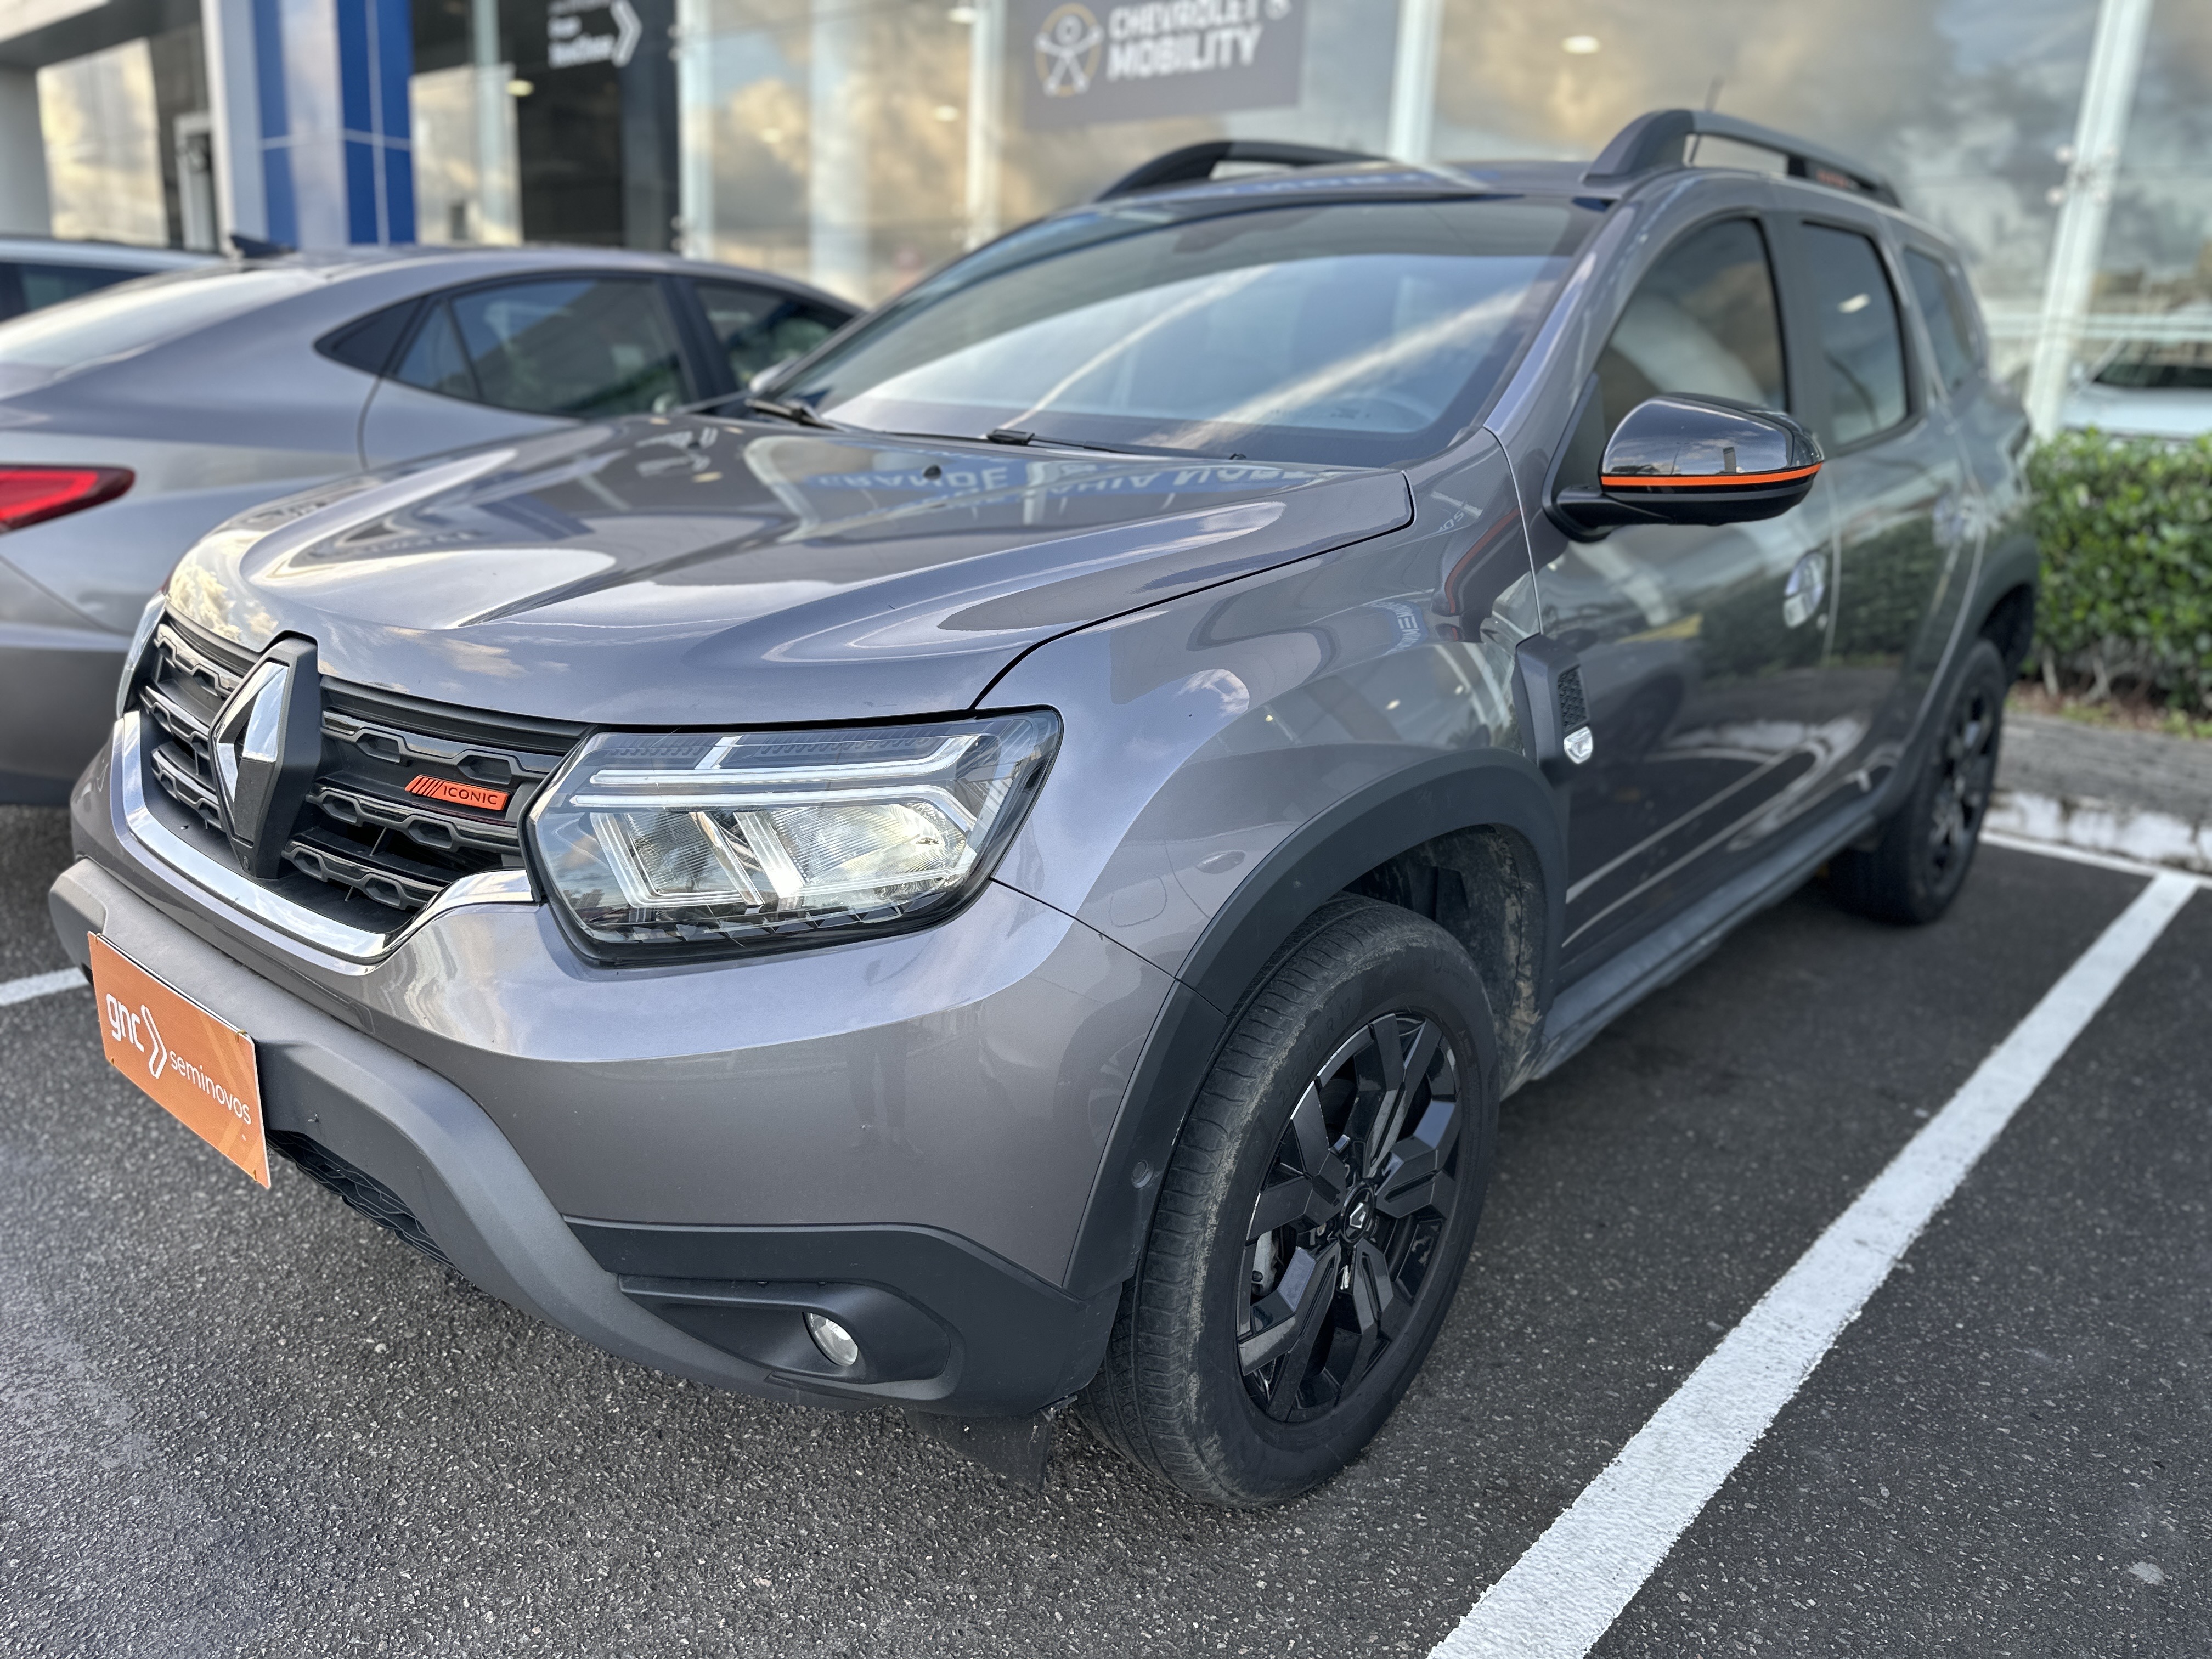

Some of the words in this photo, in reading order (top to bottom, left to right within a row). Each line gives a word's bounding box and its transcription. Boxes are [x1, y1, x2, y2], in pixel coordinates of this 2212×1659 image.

[1107, 24, 1262, 80] MOBILITY
[443, 786, 498, 805] ICONIC
[106, 993, 145, 1052] gnc
[170, 1050, 252, 1125] seminovos
